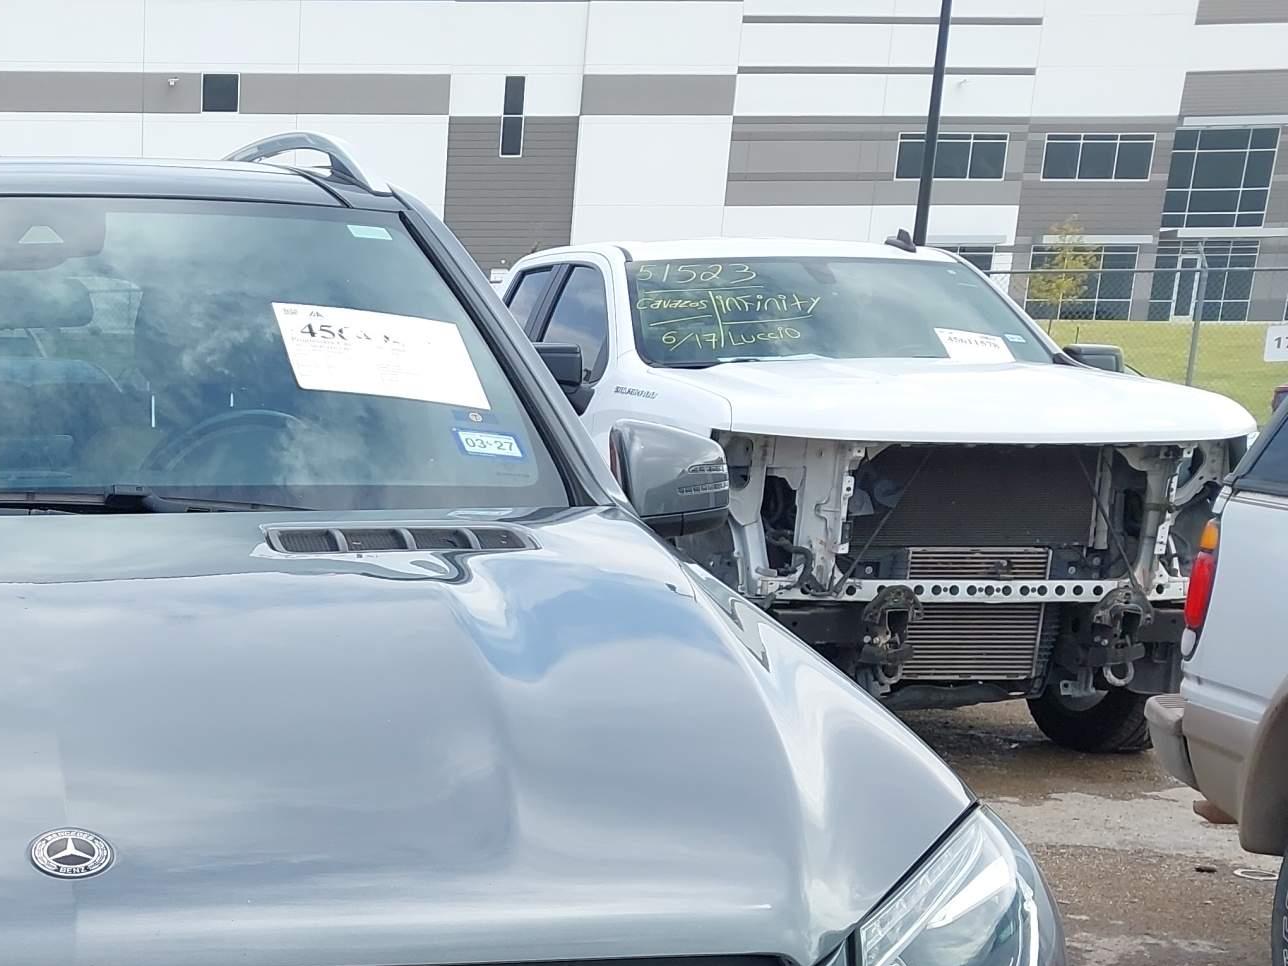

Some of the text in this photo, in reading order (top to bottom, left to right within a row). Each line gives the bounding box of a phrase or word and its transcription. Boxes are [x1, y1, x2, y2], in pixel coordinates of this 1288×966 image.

[638, 263, 758, 284] 51523
[662, 330, 718, 351] 6/17
[465, 437, 513, 452] 03 27
[59, 866, 88, 874] BENZ
